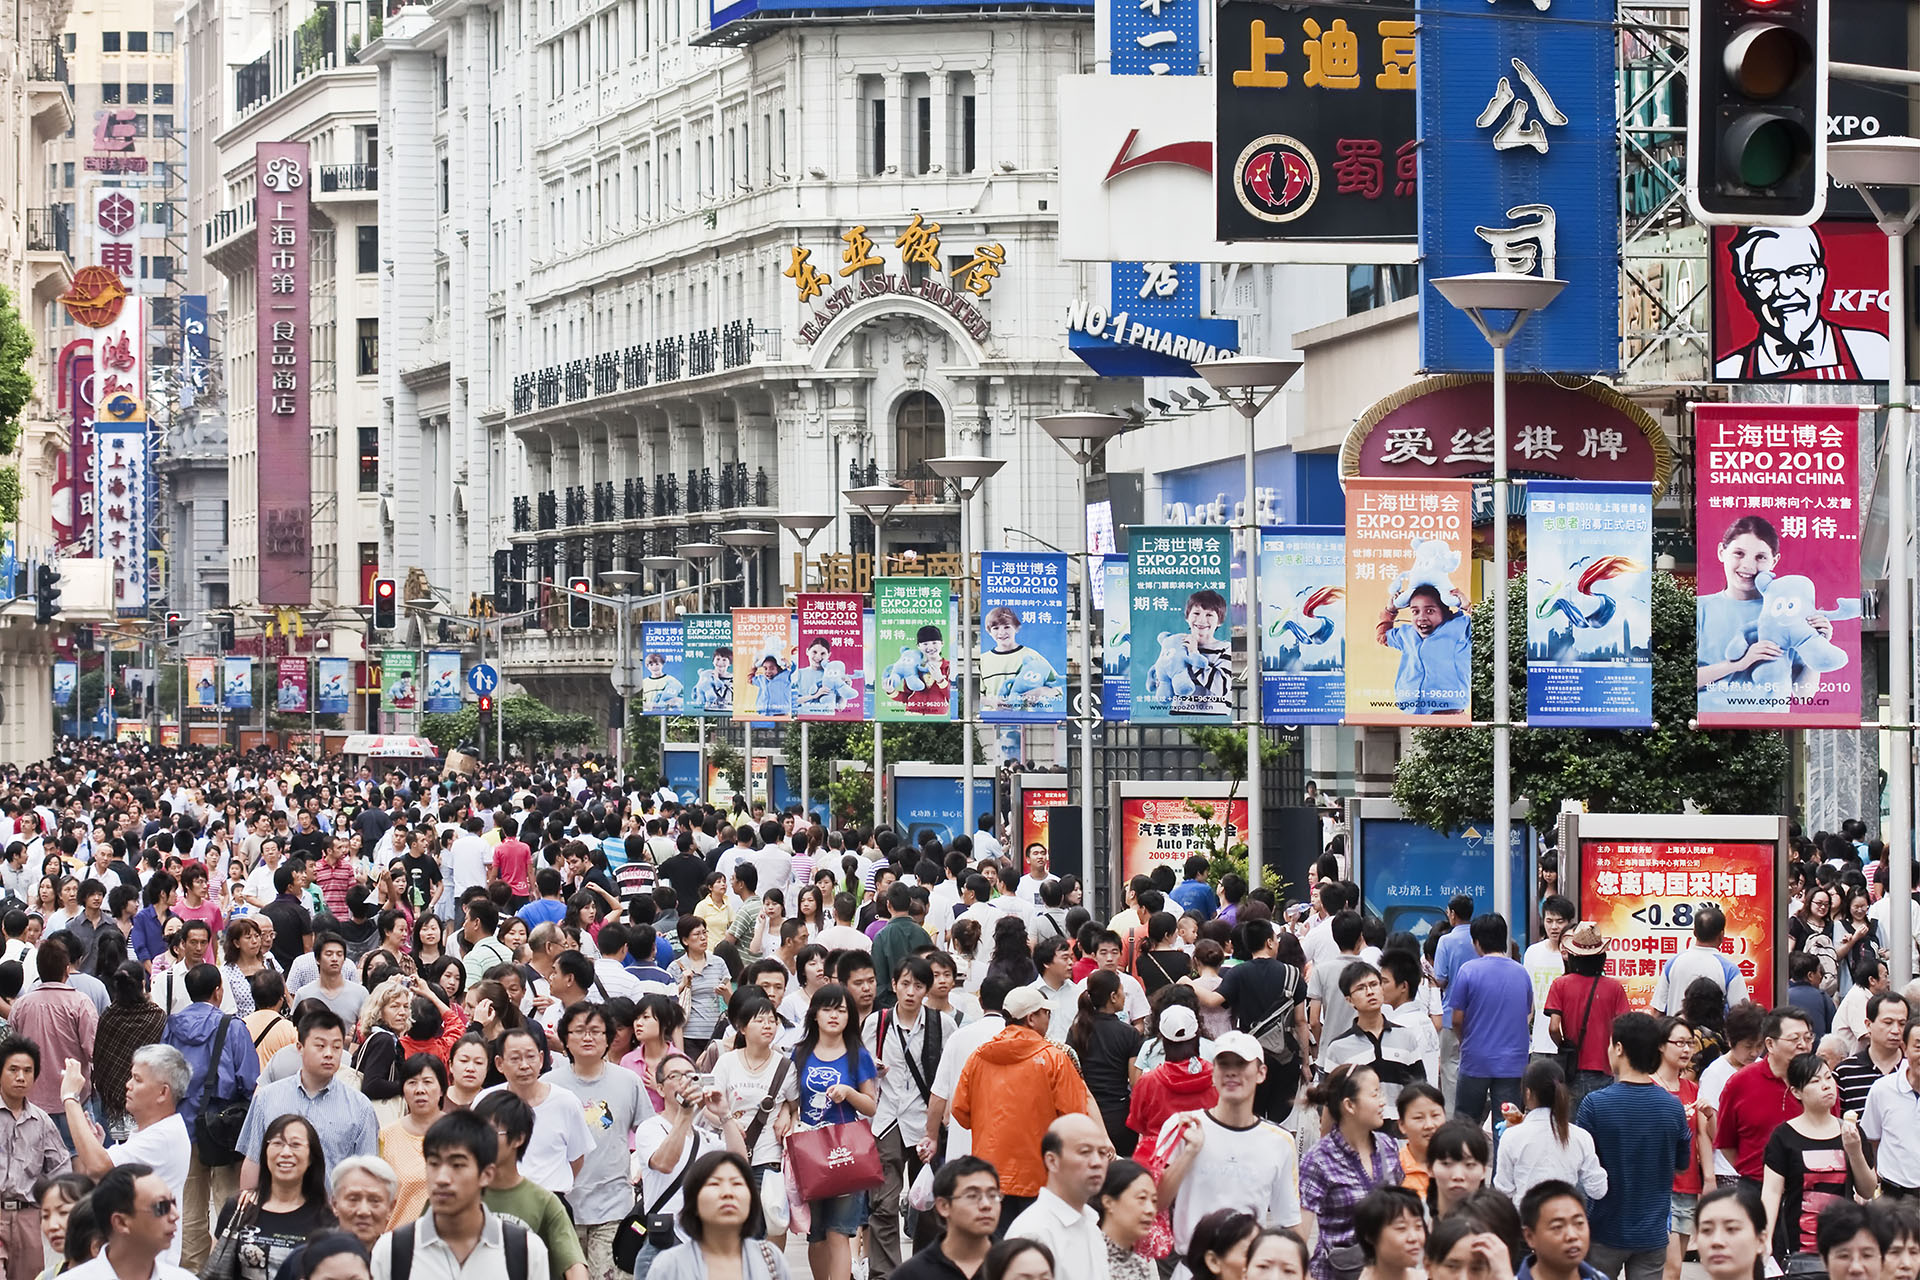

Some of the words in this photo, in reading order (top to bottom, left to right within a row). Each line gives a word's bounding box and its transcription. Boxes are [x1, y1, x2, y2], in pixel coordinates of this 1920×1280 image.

[1233, 18, 1417, 90] 上迪豆
[1826, 115, 1880, 136] XPO
[1475, 0, 1568, 281] 公司
[783, 214, 1007, 302] 东亚饭店
[270, 201, 298, 415] 上海市第一食品商店
[799, 284, 856, 346] EAST
[856, 273, 915, 301] ASIA
[920, 275, 993, 344] HOTEL
[1066, 299, 1128, 345] NO.1
[1129, 322, 1240, 363] PHARMA
[1710, 424, 1844, 448] 上海世博会
[1380, 425, 1628, 466] 爱丝棋牌
[1709, 451, 1773, 470] EXPO
[1778, 452, 1845, 470] 2010
[1710, 472, 1792, 485] SHANGHAI
[1795, 473, 1845, 485] CHINA
[1356, 493, 1460, 513] 上海世博会
[1708, 496, 1852, 510] 世博门票即将向个人发售
[1356, 514, 1405, 529] EXPO
[1409, 515, 1460, 530] 2010
[1422, 531, 1460, 541] CHINA
[1137, 537, 1221, 553] 上海世博会
[1136, 555, 1177, 566] EXPO
[1179, 555, 1221, 567] 2010
[987, 561, 1059, 576] 上海世博会
[1137, 566, 1189, 575] SHANGHAI
[1190, 567, 1221, 575] CHINA
[987, 576, 1021, 587] EXPO
[1023, 576, 1059, 587] 2010
[881, 586, 943, 598] 上海世博会
[1032, 587, 1059, 595] CHINA
[803, 601, 858, 611] 上海世博会
[881, 599, 910, 608] EXPO
[912, 599, 943, 608] 2010
[737, 615, 786, 624] 上海世博会
[803, 612, 829, 620] EXPO
[831, 612, 858, 620] 2010
[687, 620, 731, 628] 上海世博会
[761, 624, 786, 632] 2010
[1370, 700, 1450, 711] www.expo2010.cn
[1727, 697, 1830, 707] www.expo2010.cn
[942, 810, 963, 818] 知心长
[1156, 838, 1183, 850] Auto
[1186, 839, 1205, 850] Par
[1596, 871, 1757, 897] 您离跨国采购商
[1387, 885, 1433, 897] 成功路上
[1440, 885, 1486, 897] 知心长伴
